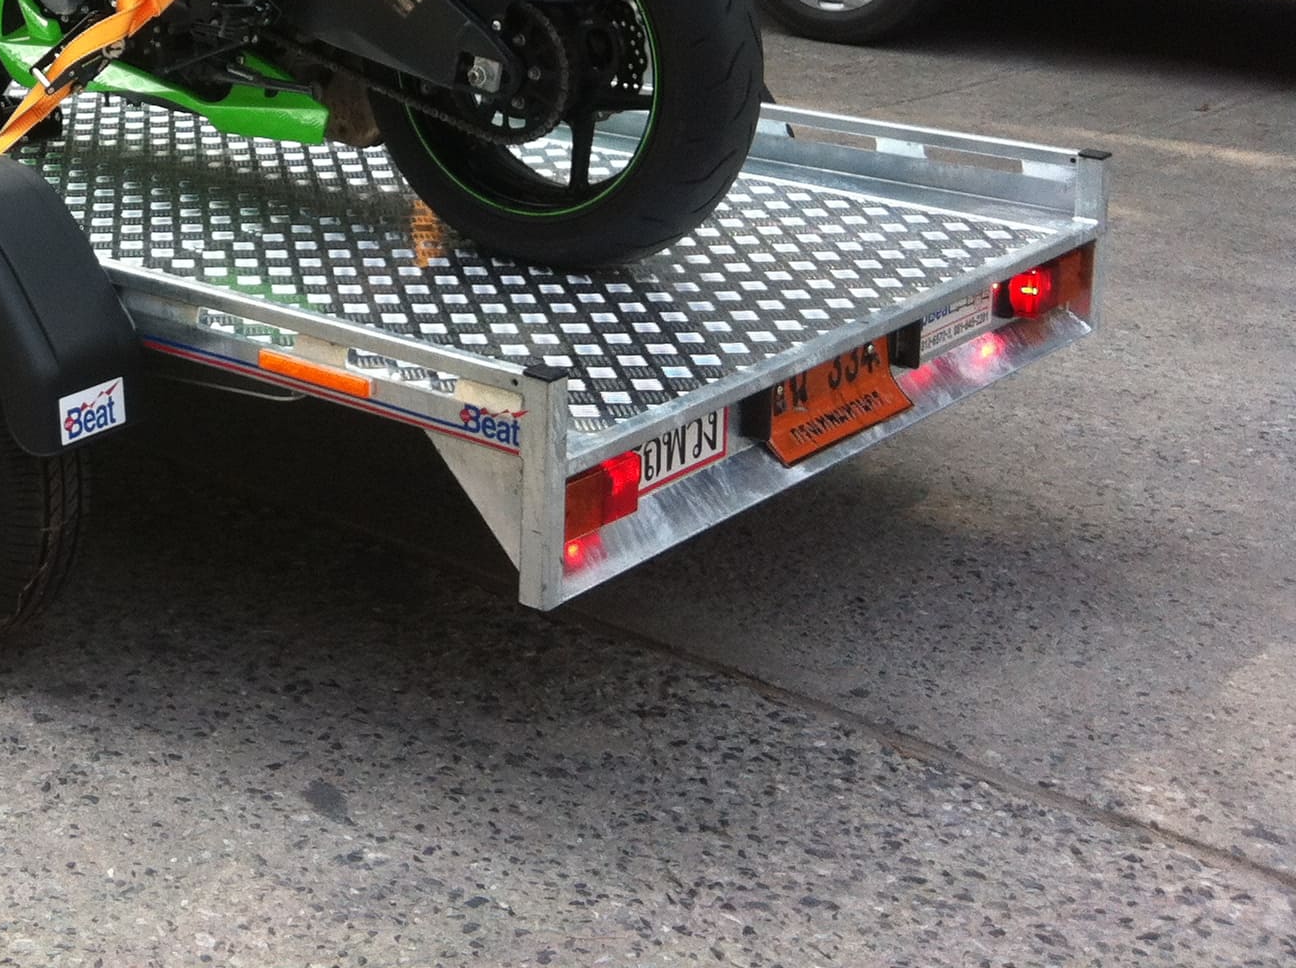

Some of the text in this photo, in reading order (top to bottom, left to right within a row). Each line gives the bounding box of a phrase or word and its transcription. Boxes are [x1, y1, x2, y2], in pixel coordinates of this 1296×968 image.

[65, 395, 116, 440] Beat
[460, 403, 520, 447] Beat
[632, 410, 718, 482] ถพวง
